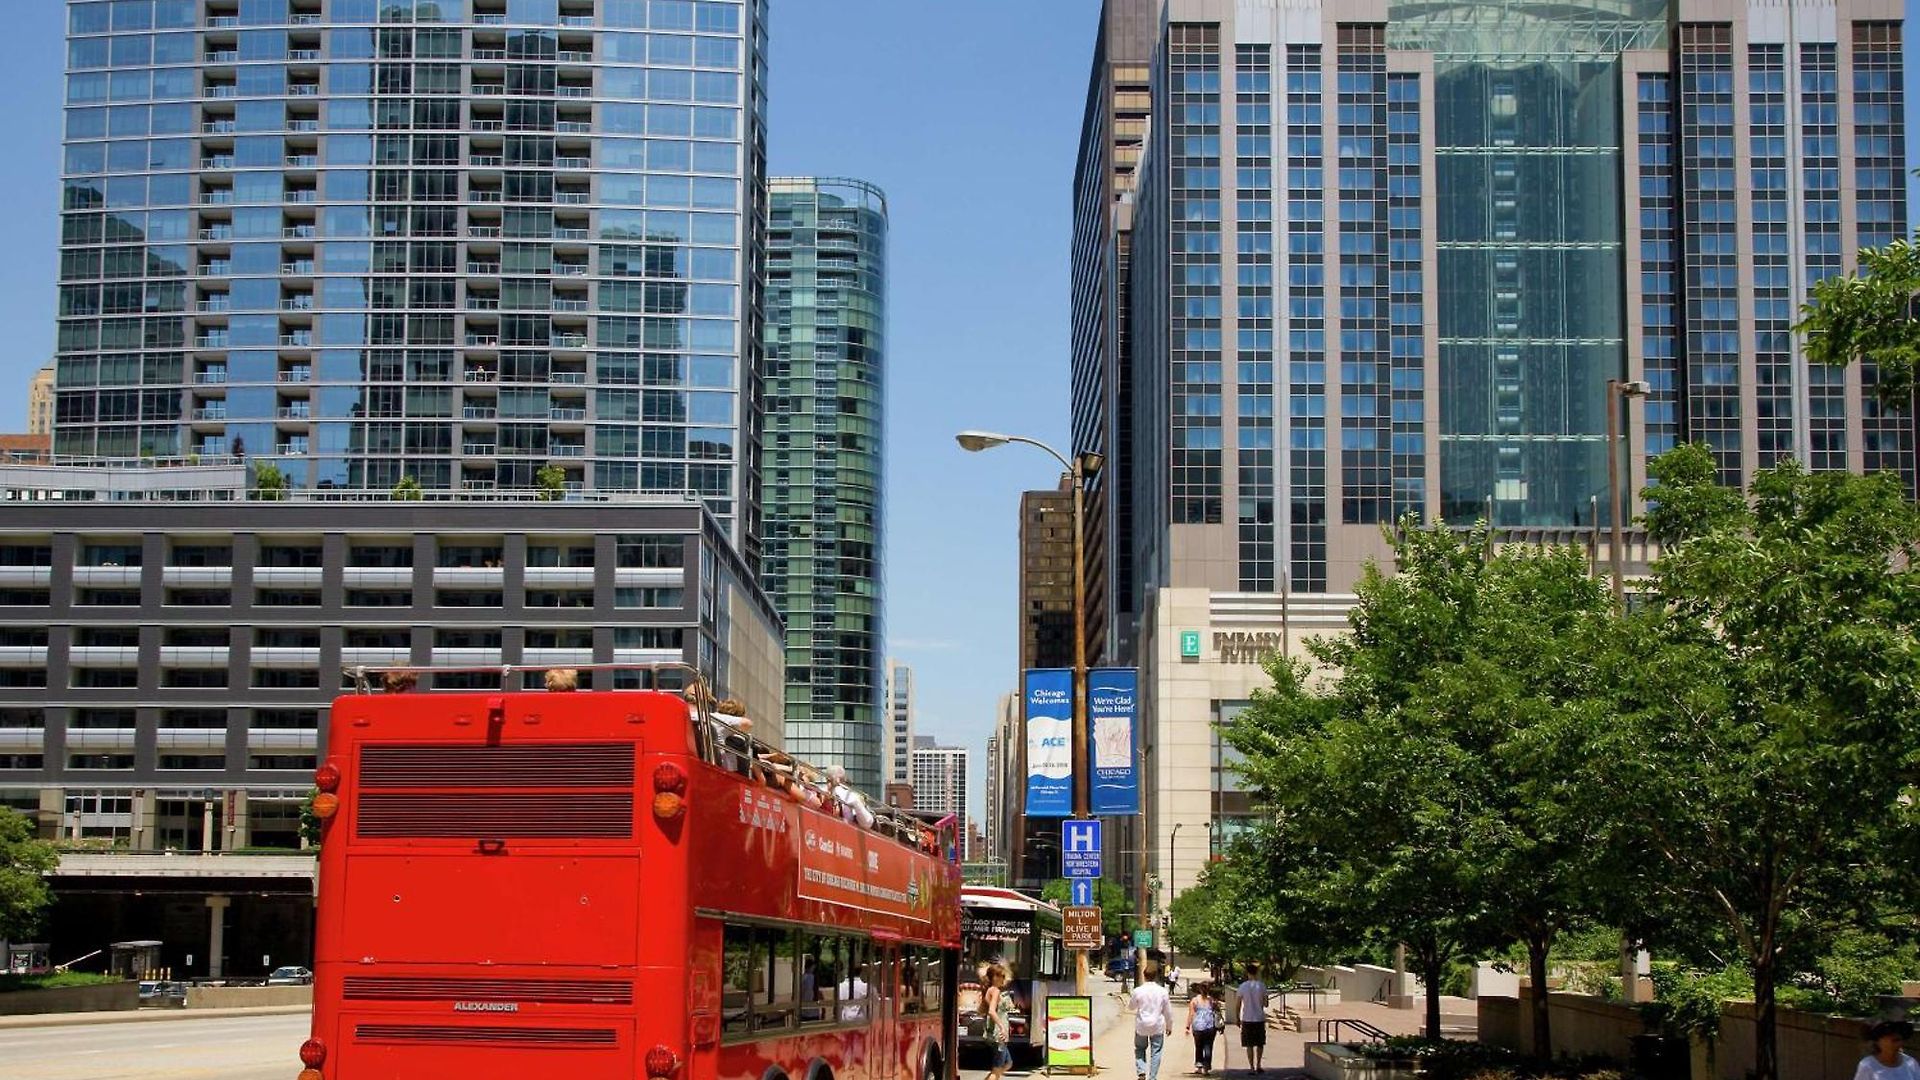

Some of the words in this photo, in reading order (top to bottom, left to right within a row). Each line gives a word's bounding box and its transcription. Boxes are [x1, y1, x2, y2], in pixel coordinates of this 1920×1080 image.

[1186, 635, 1197, 652] E
[1213, 632, 1282, 648] EMBASSY
[1034, 689, 1066, 698] Chicago
[1030, 696, 1070, 705] Welcomes
[1094, 697, 1114, 705] We're
[1115, 696, 1131, 705] Glad
[1092, 705, 1113, 713] You're
[1042, 737, 1065, 747] ACE
[1071, 826, 1093, 851] H
[1068, 910, 1096, 918] MILTON
[991, 926, 1031, 935] FIREWORKS
[1065, 925, 1090, 933] OLIVE
[1091, 925, 1099, 933] III
[1072, 932, 1093, 941] PARK
[453, 1001, 518, 1012] ALEXANDER
